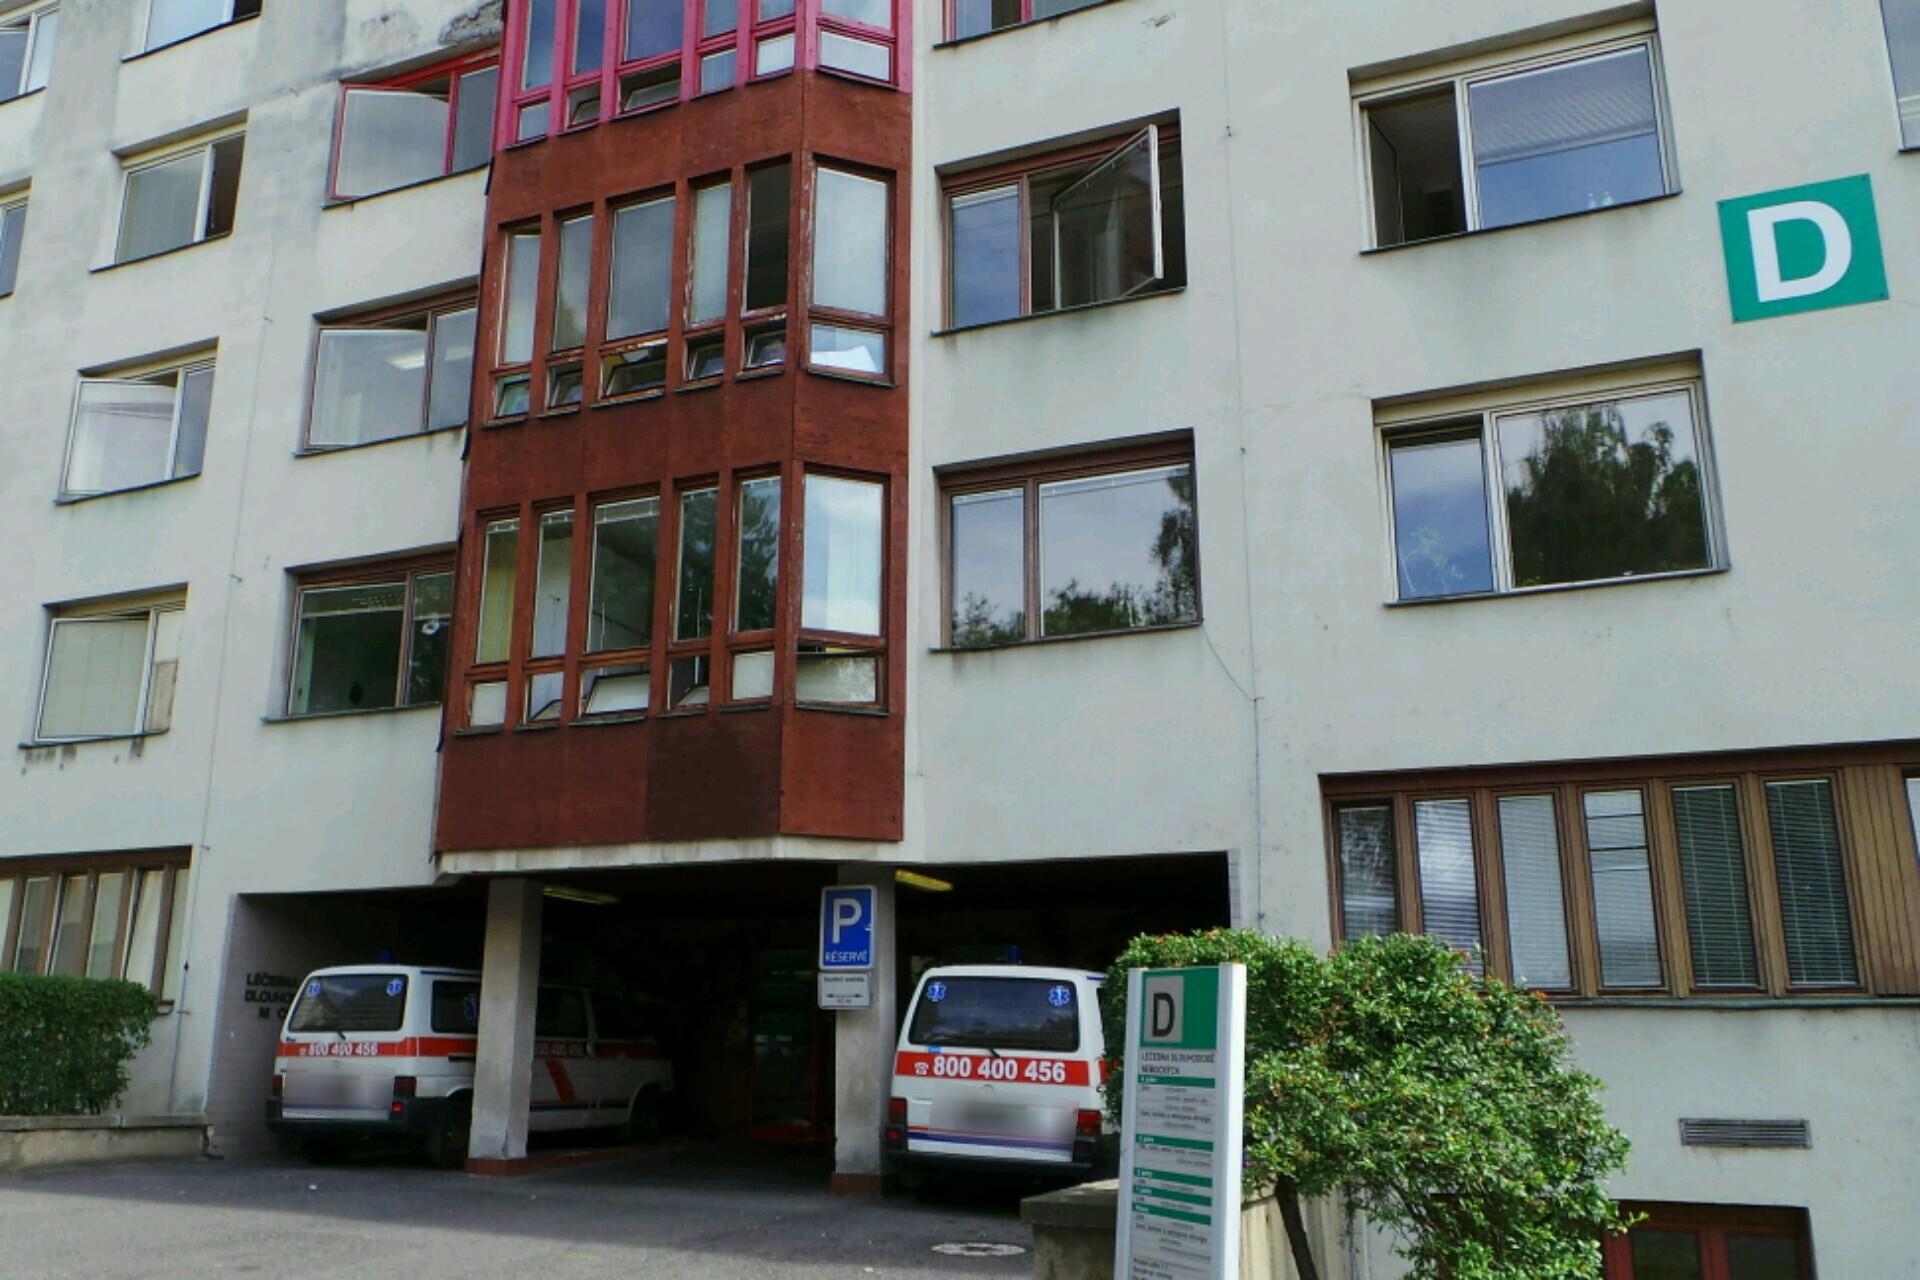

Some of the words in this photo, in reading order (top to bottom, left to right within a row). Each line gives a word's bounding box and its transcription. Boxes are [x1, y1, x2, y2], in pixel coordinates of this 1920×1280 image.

[1747, 200, 1852, 303] D
[832, 898, 862, 945] P
[1152, 992, 1175, 1037] D
[308, 1042, 328, 1056] 800
[331, 1042, 353, 1056] 400
[355, 1042, 378, 1056] 456
[933, 1056, 972, 1077] 800
[977, 1057, 1018, 1080] 400
[1024, 1060, 1067, 1083] 456
